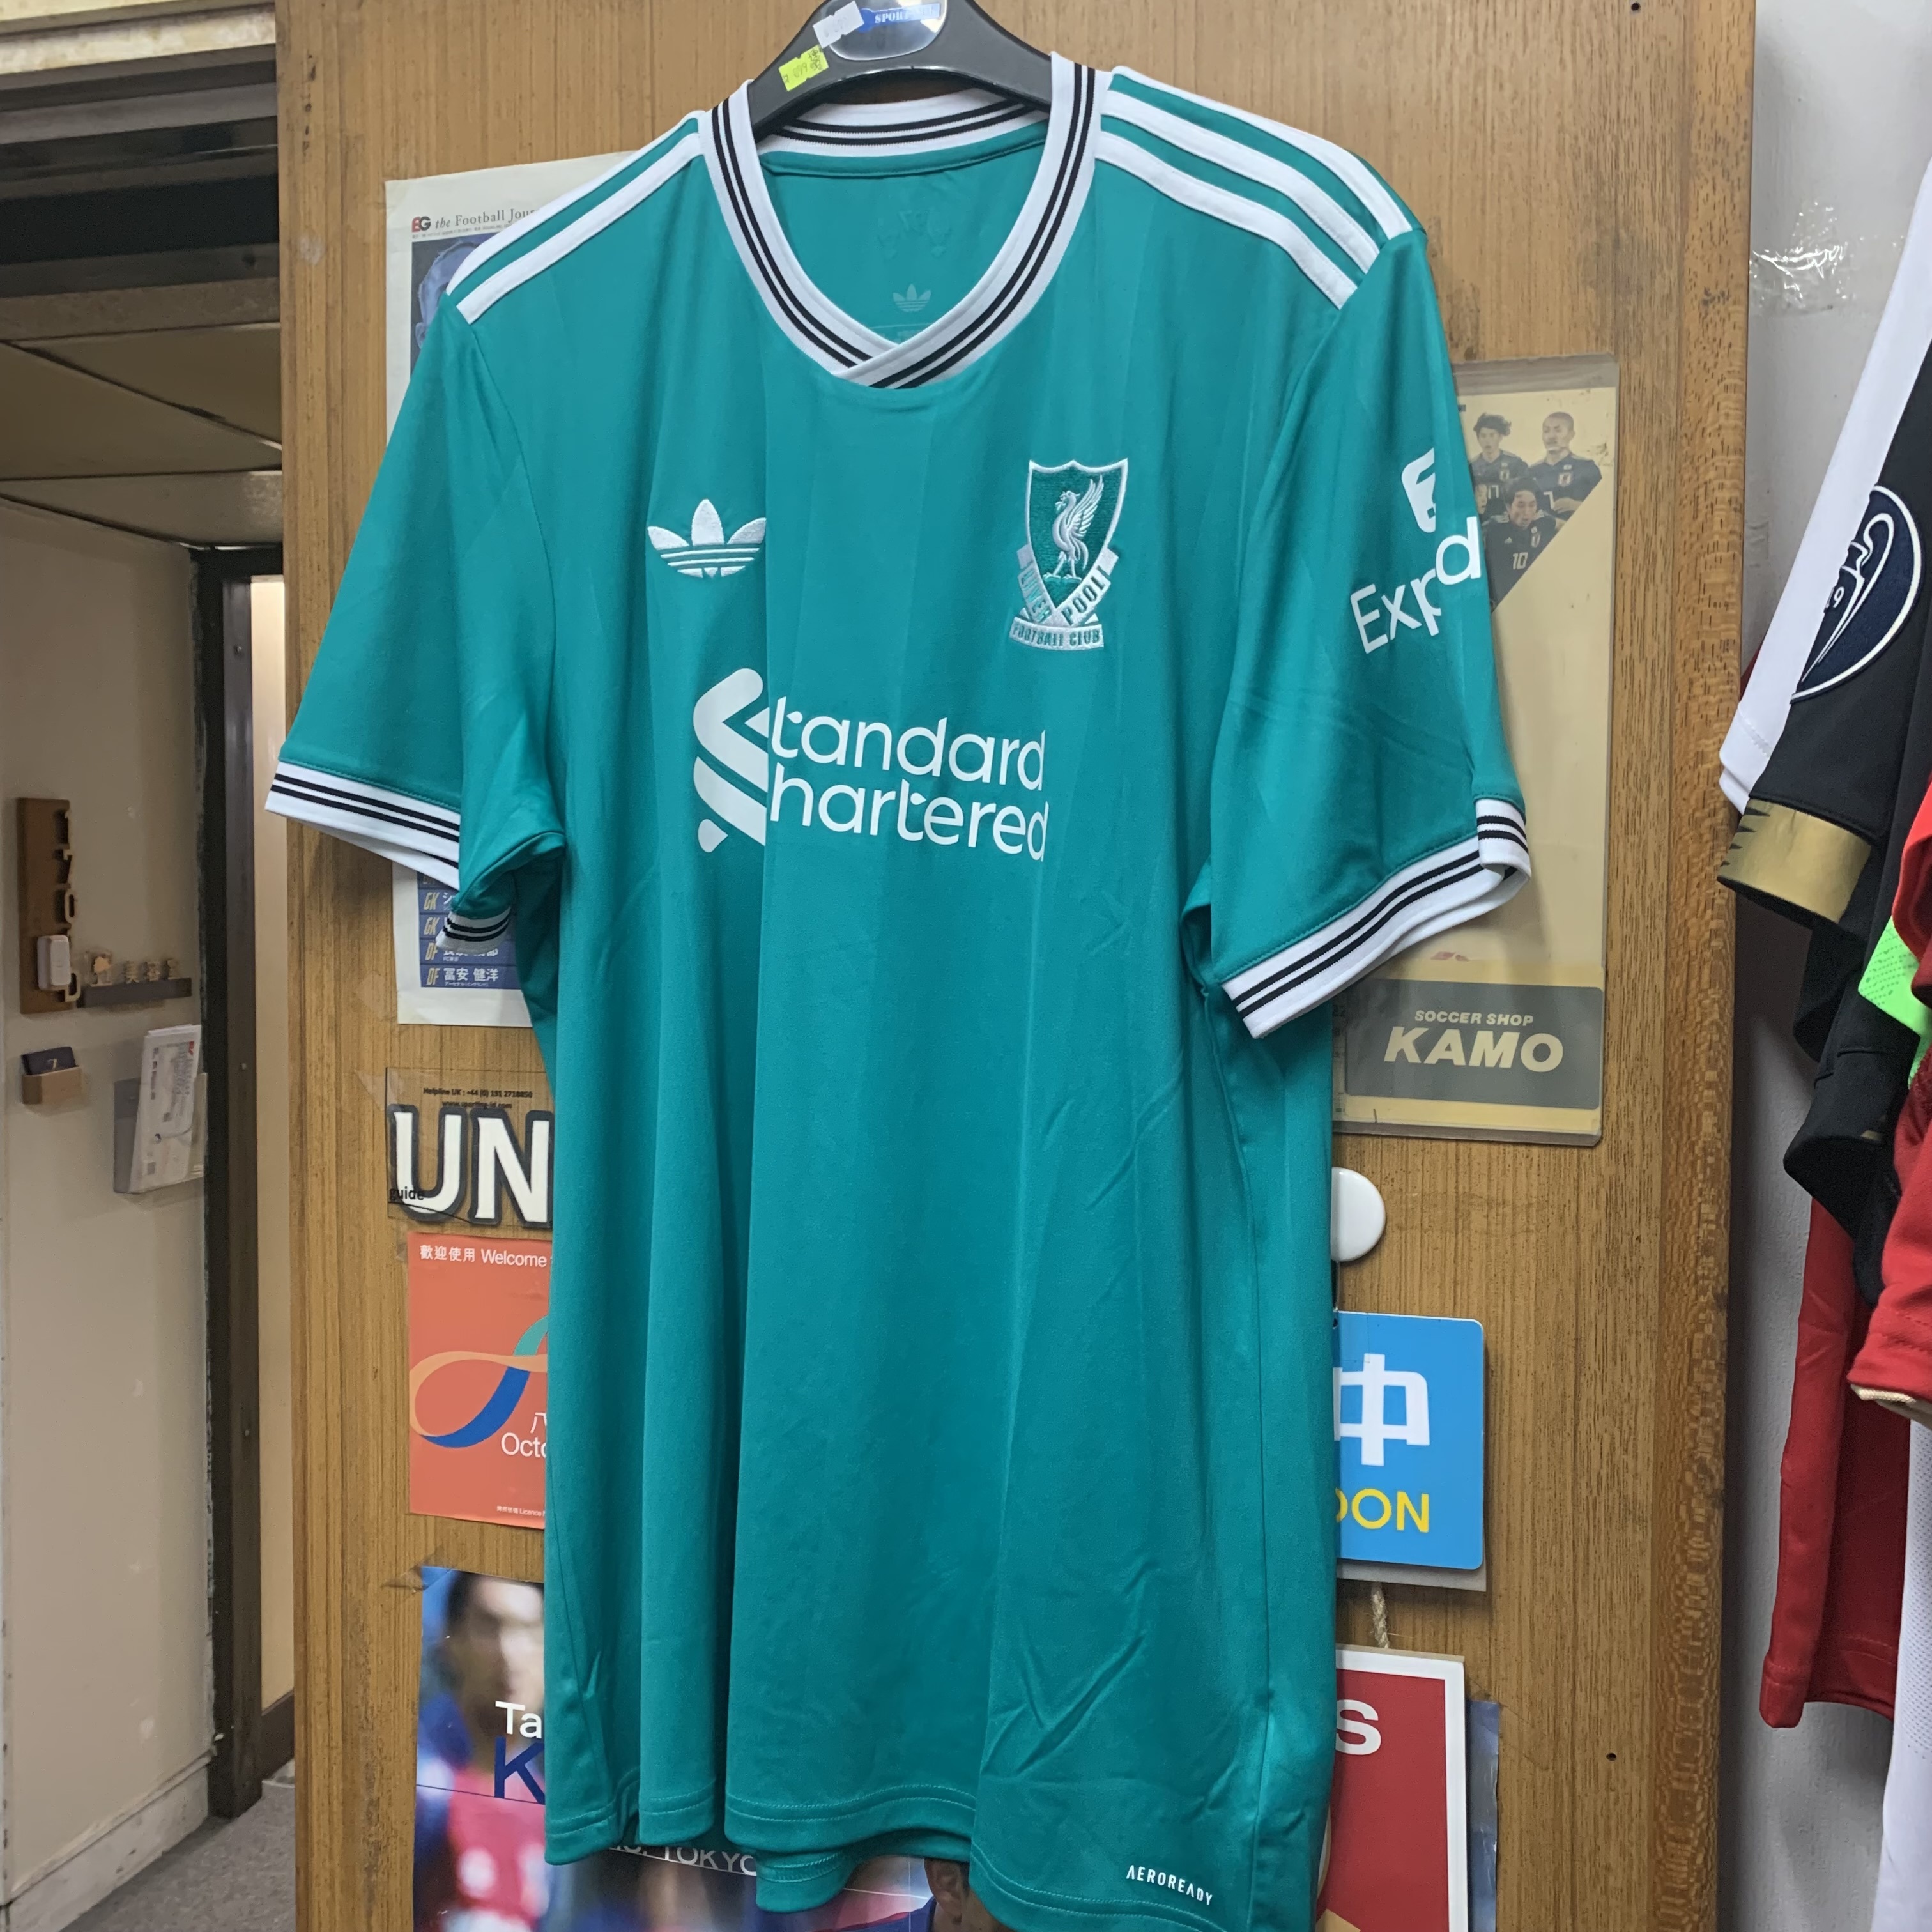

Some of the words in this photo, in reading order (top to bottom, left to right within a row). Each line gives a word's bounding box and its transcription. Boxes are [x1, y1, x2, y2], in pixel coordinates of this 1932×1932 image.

[435, 217, 451, 229] the
[455, 209, 505, 226] Football
[1512, 552, 1529, 570] 10
[1062, 576, 1106, 625] POOL
[1011, 625, 1064, 647] FOOTBALL
[1069, 628, 1100, 647] CLUB
[426, 967, 441, 986] DF
[1414, 1009, 1482, 1025] SOCCER
[1486, 1013, 1534, 1027] SHOP
[1383, 1026, 1563, 1073] KAMO
[389, 1186, 424, 1201] guide
[480, 1248, 548, 1268] Welcome
[1126, 1864, 1213, 1906] AEROREADY
